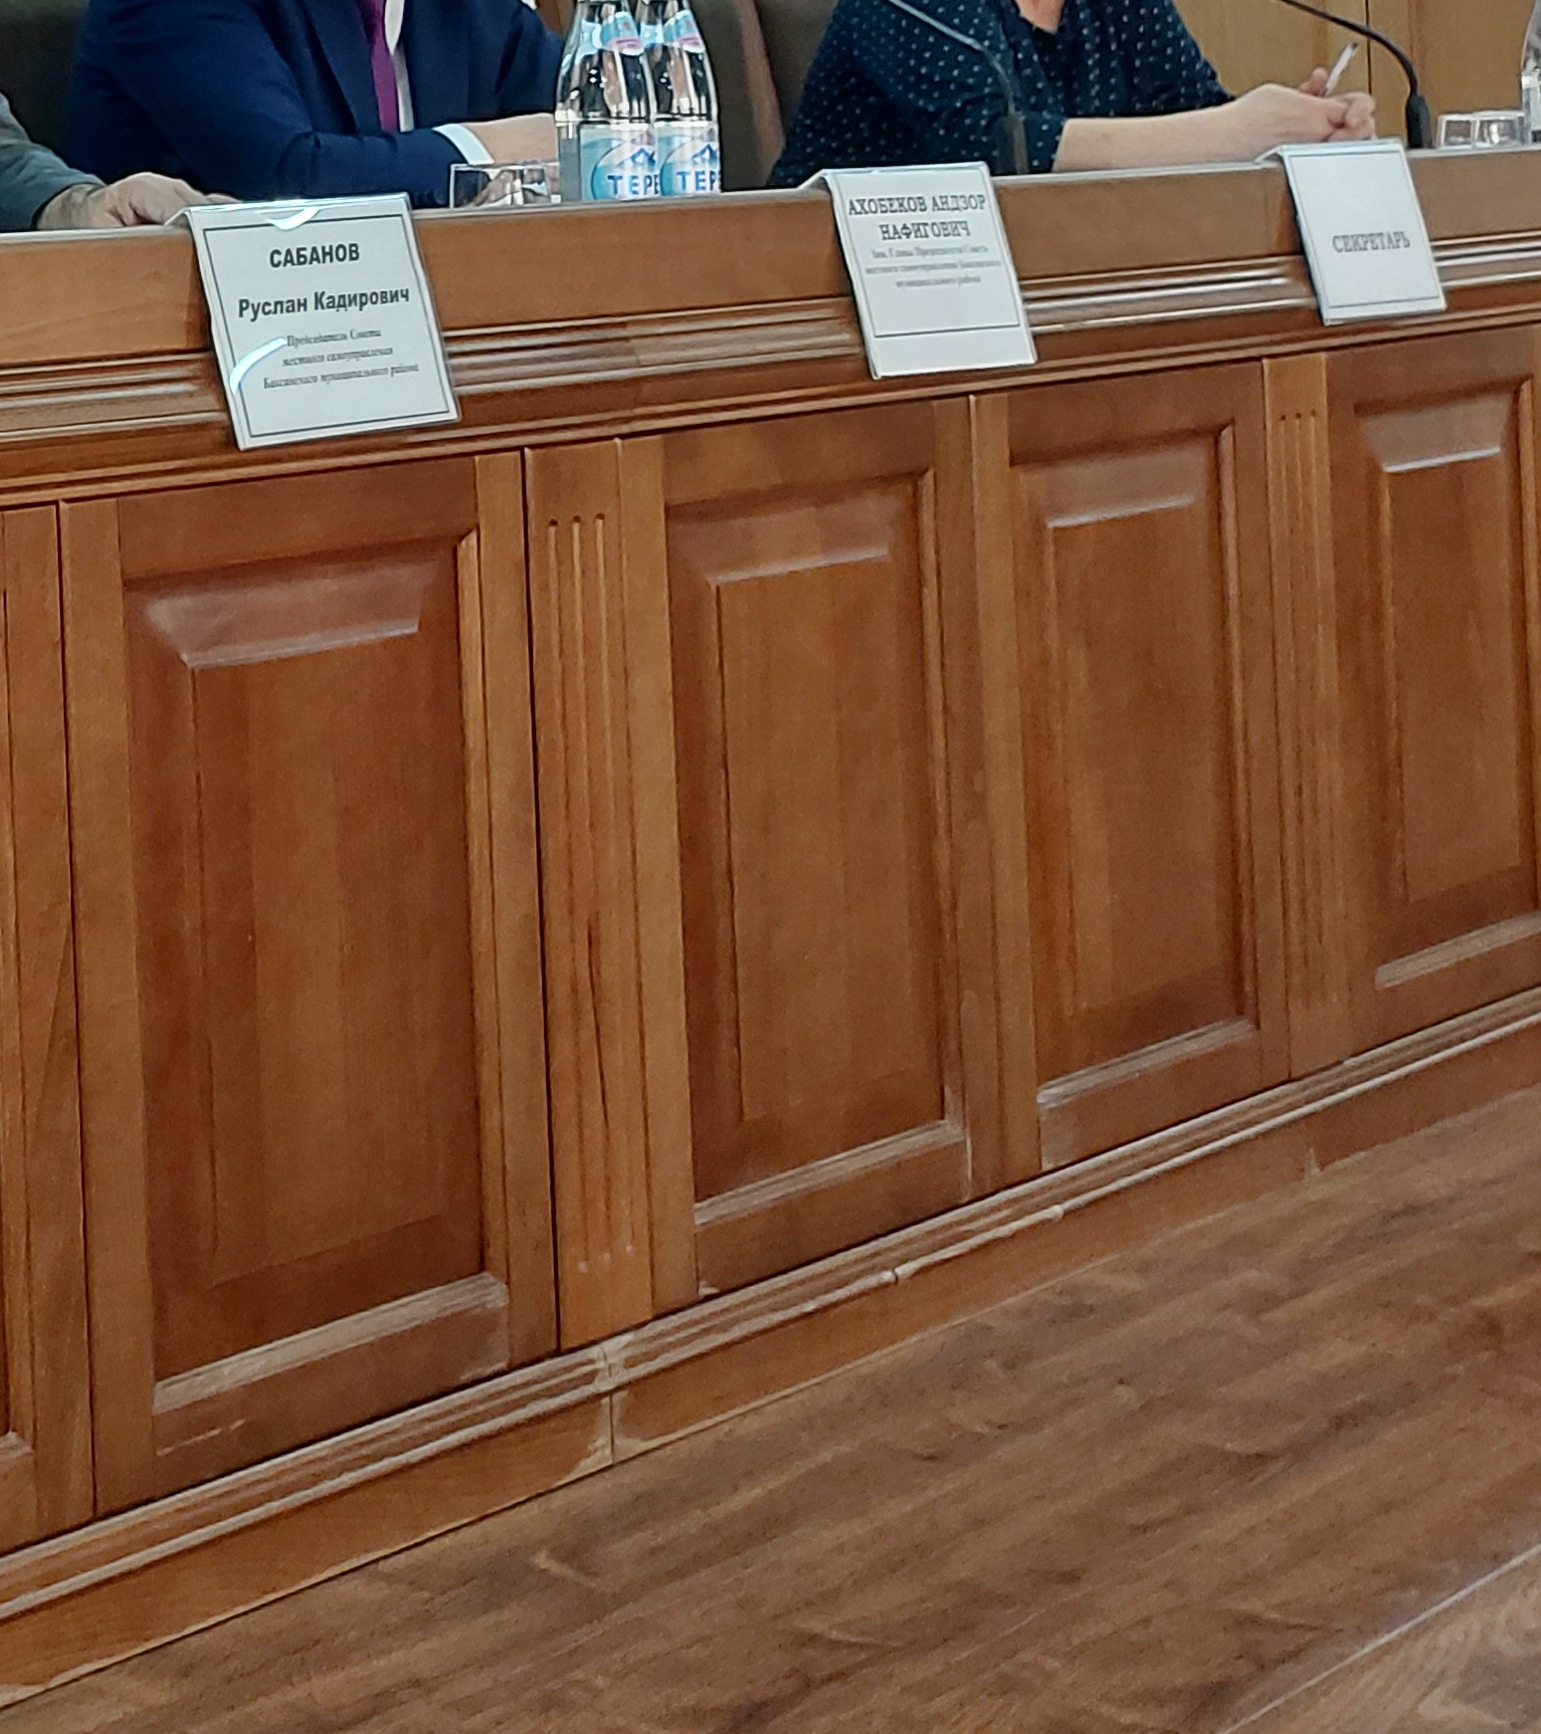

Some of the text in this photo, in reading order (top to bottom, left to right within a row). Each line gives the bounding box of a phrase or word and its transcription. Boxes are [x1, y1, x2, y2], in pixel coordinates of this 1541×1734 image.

[848, 194, 986, 216] АХОБЕКОВ АНДЗОР
[879, 220, 970, 241] НАФИГОВИЧ
[1332, 231, 1411, 253] СЕКРЕТАРЬ
[269, 242, 360, 268] САБАНОВ
[238, 288, 410, 322] Руслан Кадирович
